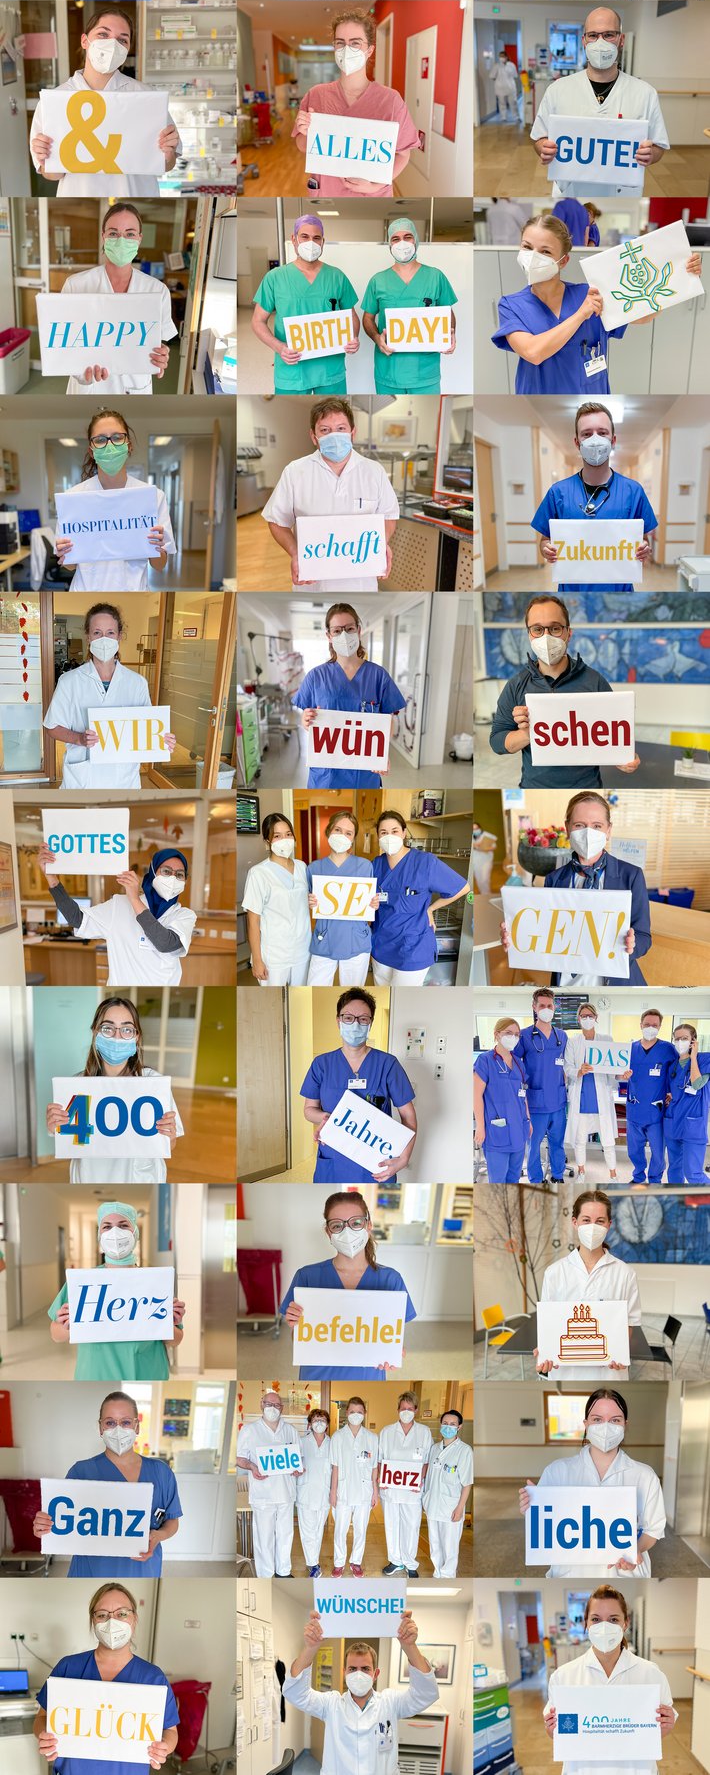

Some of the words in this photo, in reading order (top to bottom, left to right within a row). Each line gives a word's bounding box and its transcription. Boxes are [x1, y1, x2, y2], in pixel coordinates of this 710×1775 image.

[59, 90, 122, 174] &
[308, 134, 392, 163] ALLES
[45, 321, 158, 349] HAPPY
[289, 316, 351, 352] BIRTH
[389, 317, 448, 343] DAY!
[62, 515, 156, 535] HOSPITALITÄT
[304, 531, 380, 564] schafft
[94, 719, 164, 751] WIR
[313, 721, 384, 757] wün
[534, 711, 630, 746] schen
[48, 833, 126, 854] GOTTES
[316, 883, 372, 916] SE
[512, 908, 626, 959] GEN!
[589, 1047, 629, 1067] DAS
[60, 1095, 164, 1145] 400
[333, 1106, 393, 1160] Jahre.
[74, 1284, 167, 1323] Herz
[298, 1315, 402, 1343] befehle!
[259, 1448, 300, 1471] viele
[382, 1464, 419, 1486] herz
[48, 1496, 145, 1537] Ganz
[530, 1505, 632, 1549] liche
[316, 1594, 404, 1614] WÜNSCHE!
[50, 1704, 160, 1741] GLÜCK
